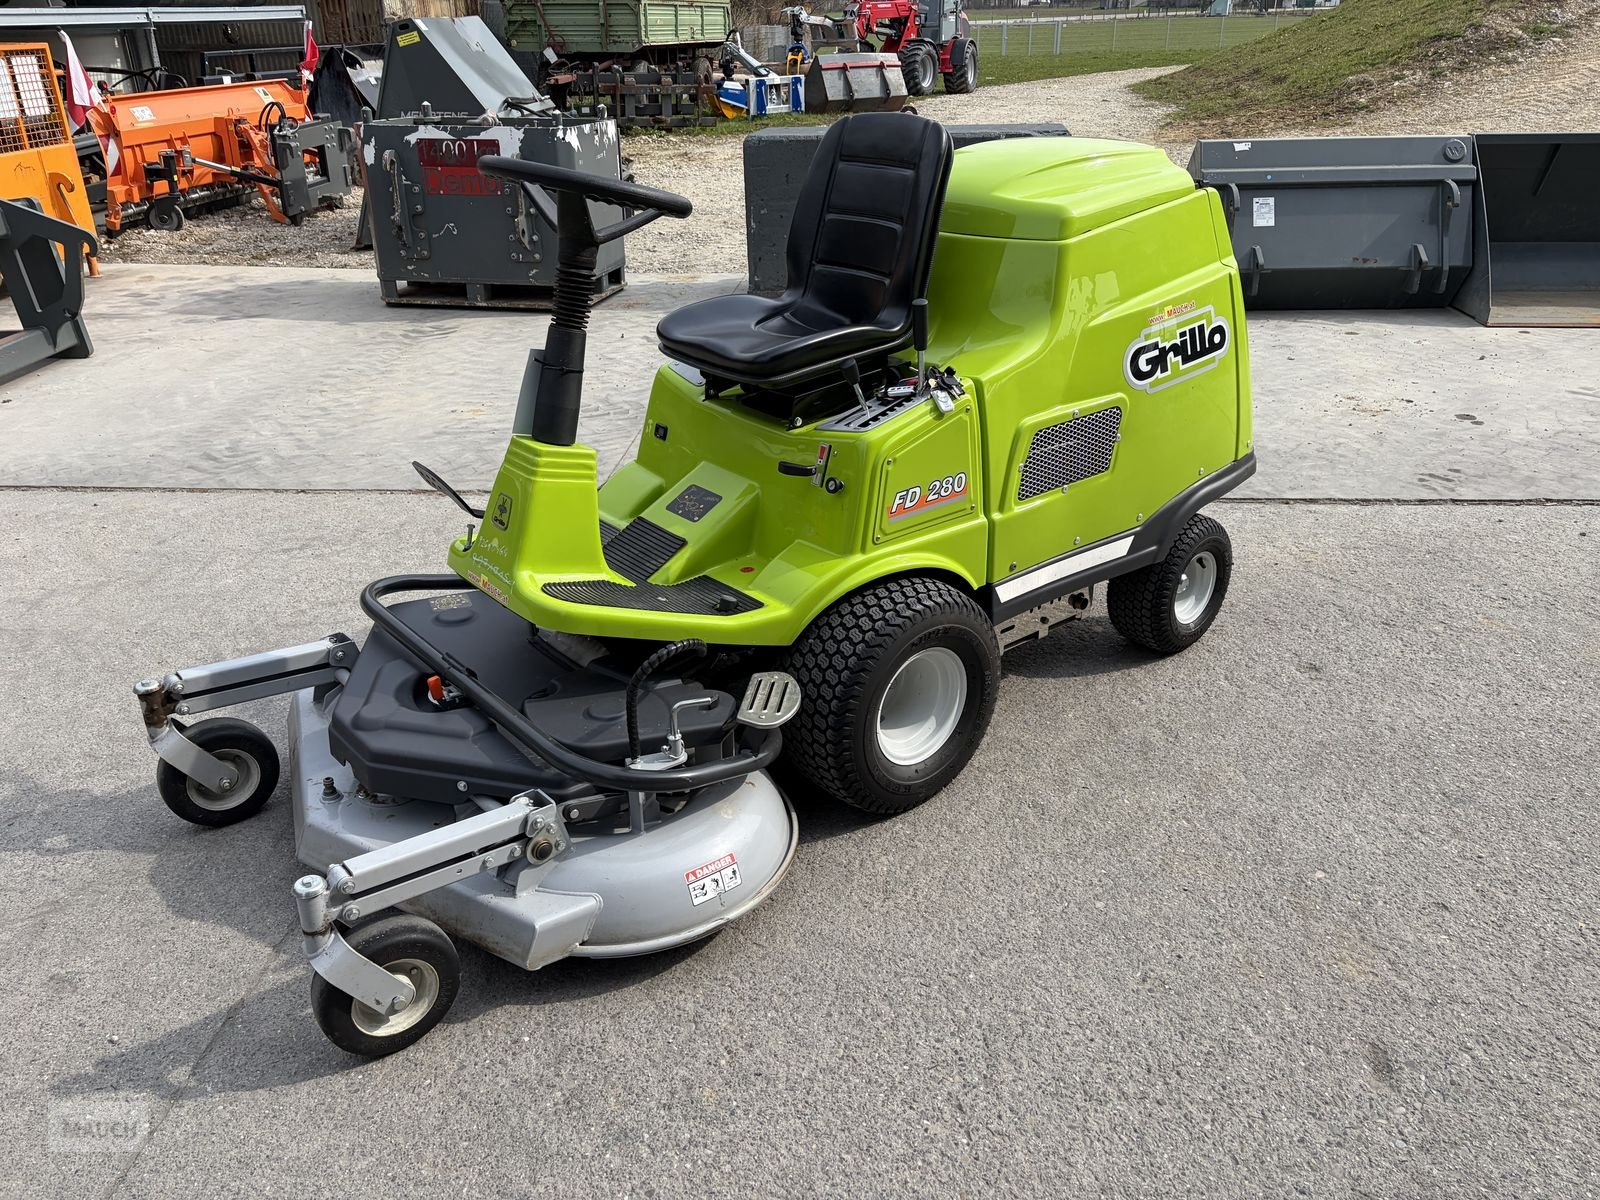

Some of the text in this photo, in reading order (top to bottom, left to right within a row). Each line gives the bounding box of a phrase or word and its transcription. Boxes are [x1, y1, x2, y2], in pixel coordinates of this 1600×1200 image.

[1128, 321, 1228, 382] Grillo
[889, 471, 968, 515] FD 280
[695, 855, 733, 877] DANGER
